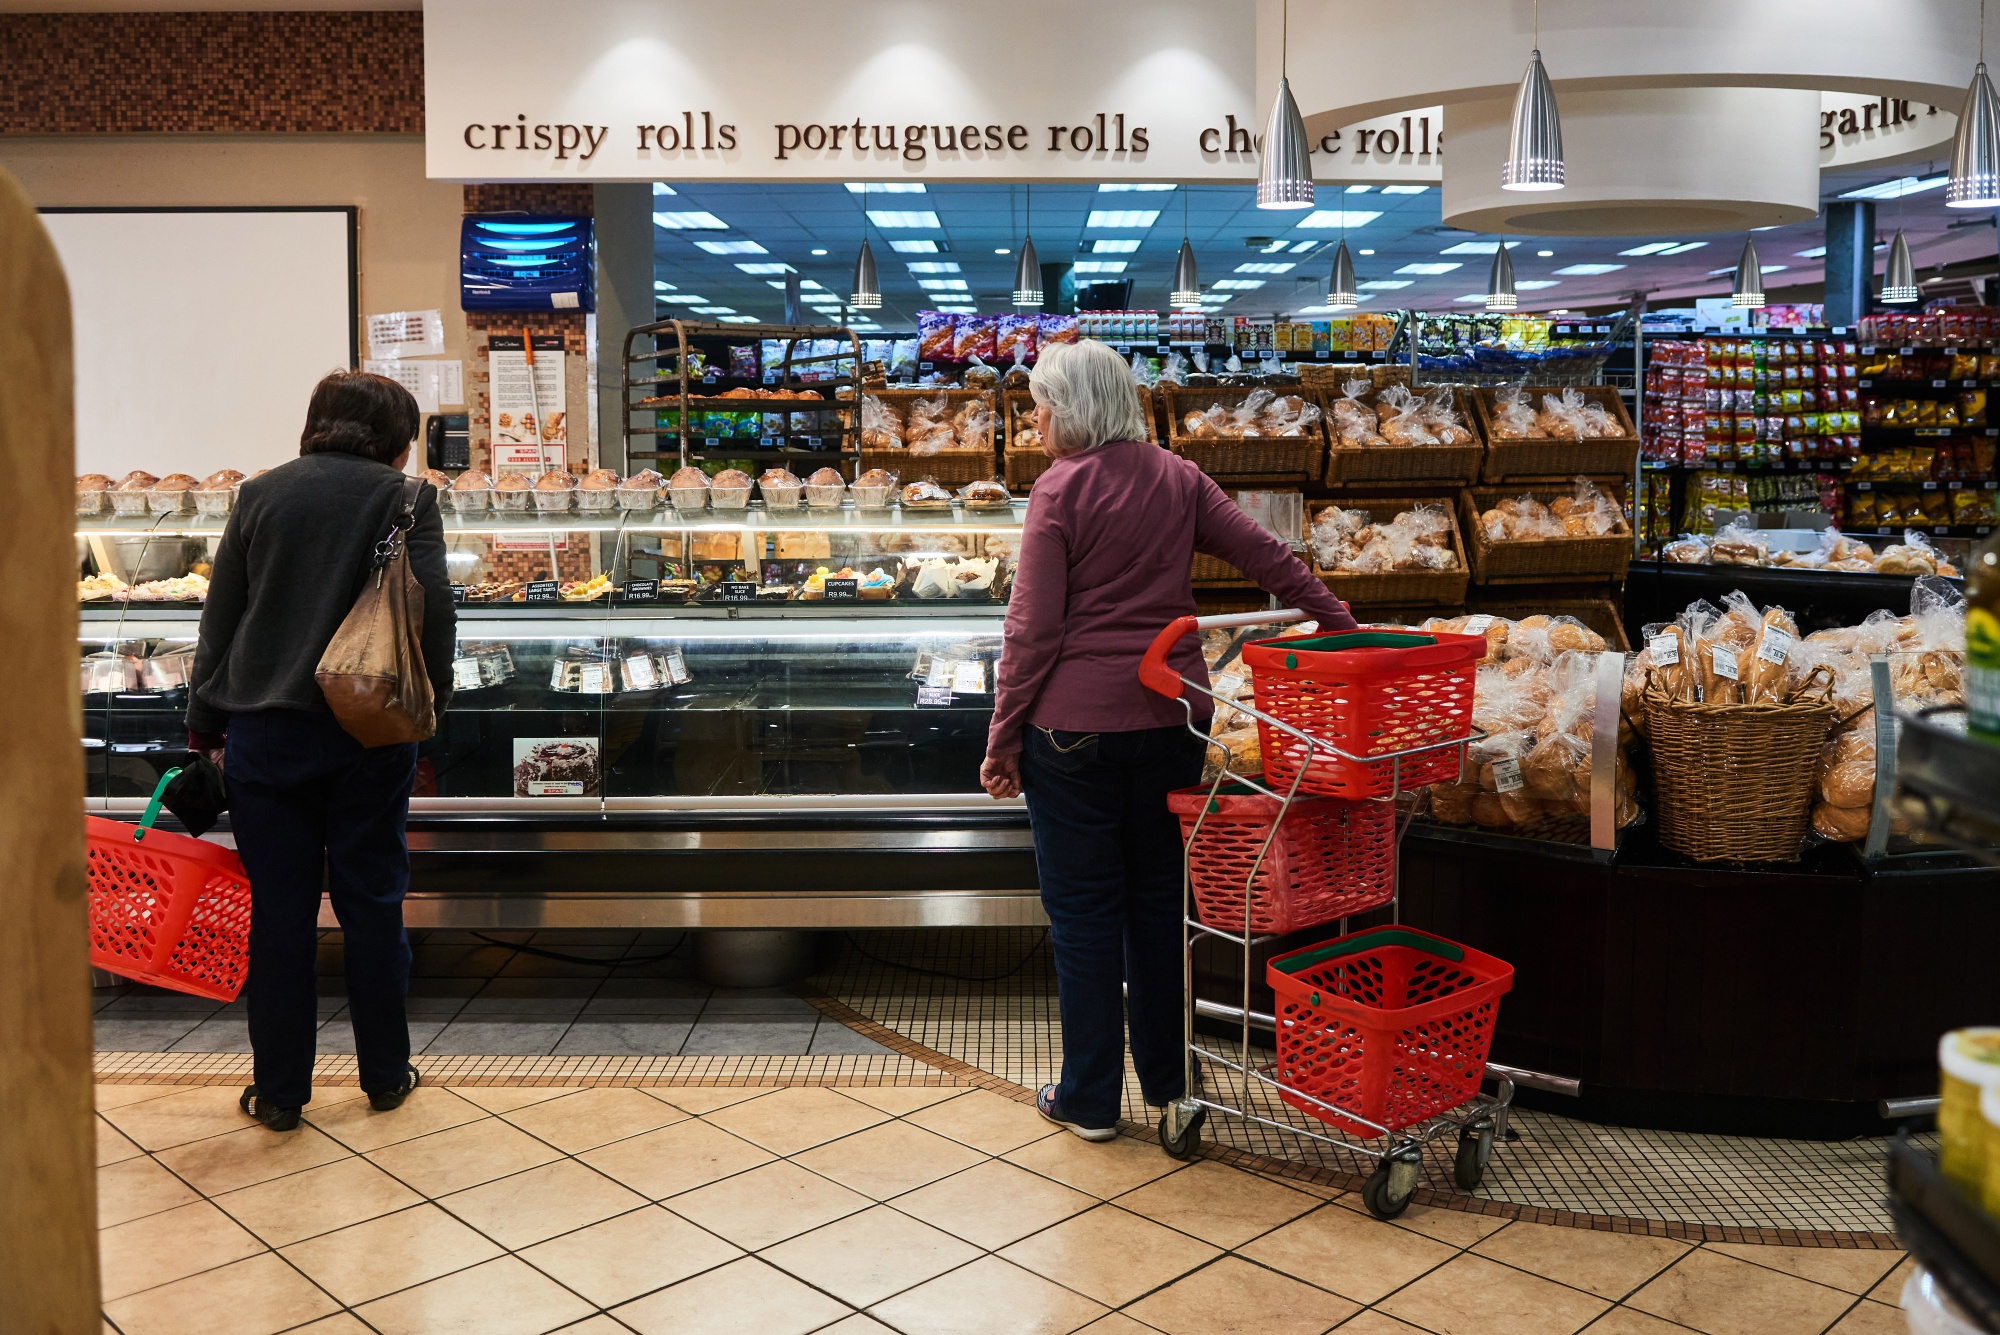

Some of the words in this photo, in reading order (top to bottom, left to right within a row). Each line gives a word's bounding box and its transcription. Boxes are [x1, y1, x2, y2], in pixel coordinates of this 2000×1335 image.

[464, 114, 608, 160] crispy
[636, 112, 736, 151] rolls
[774, 117, 1028, 161] portuguese
[1048, 114, 1149, 153] rolls
[1199, 115, 1342, 154] che
